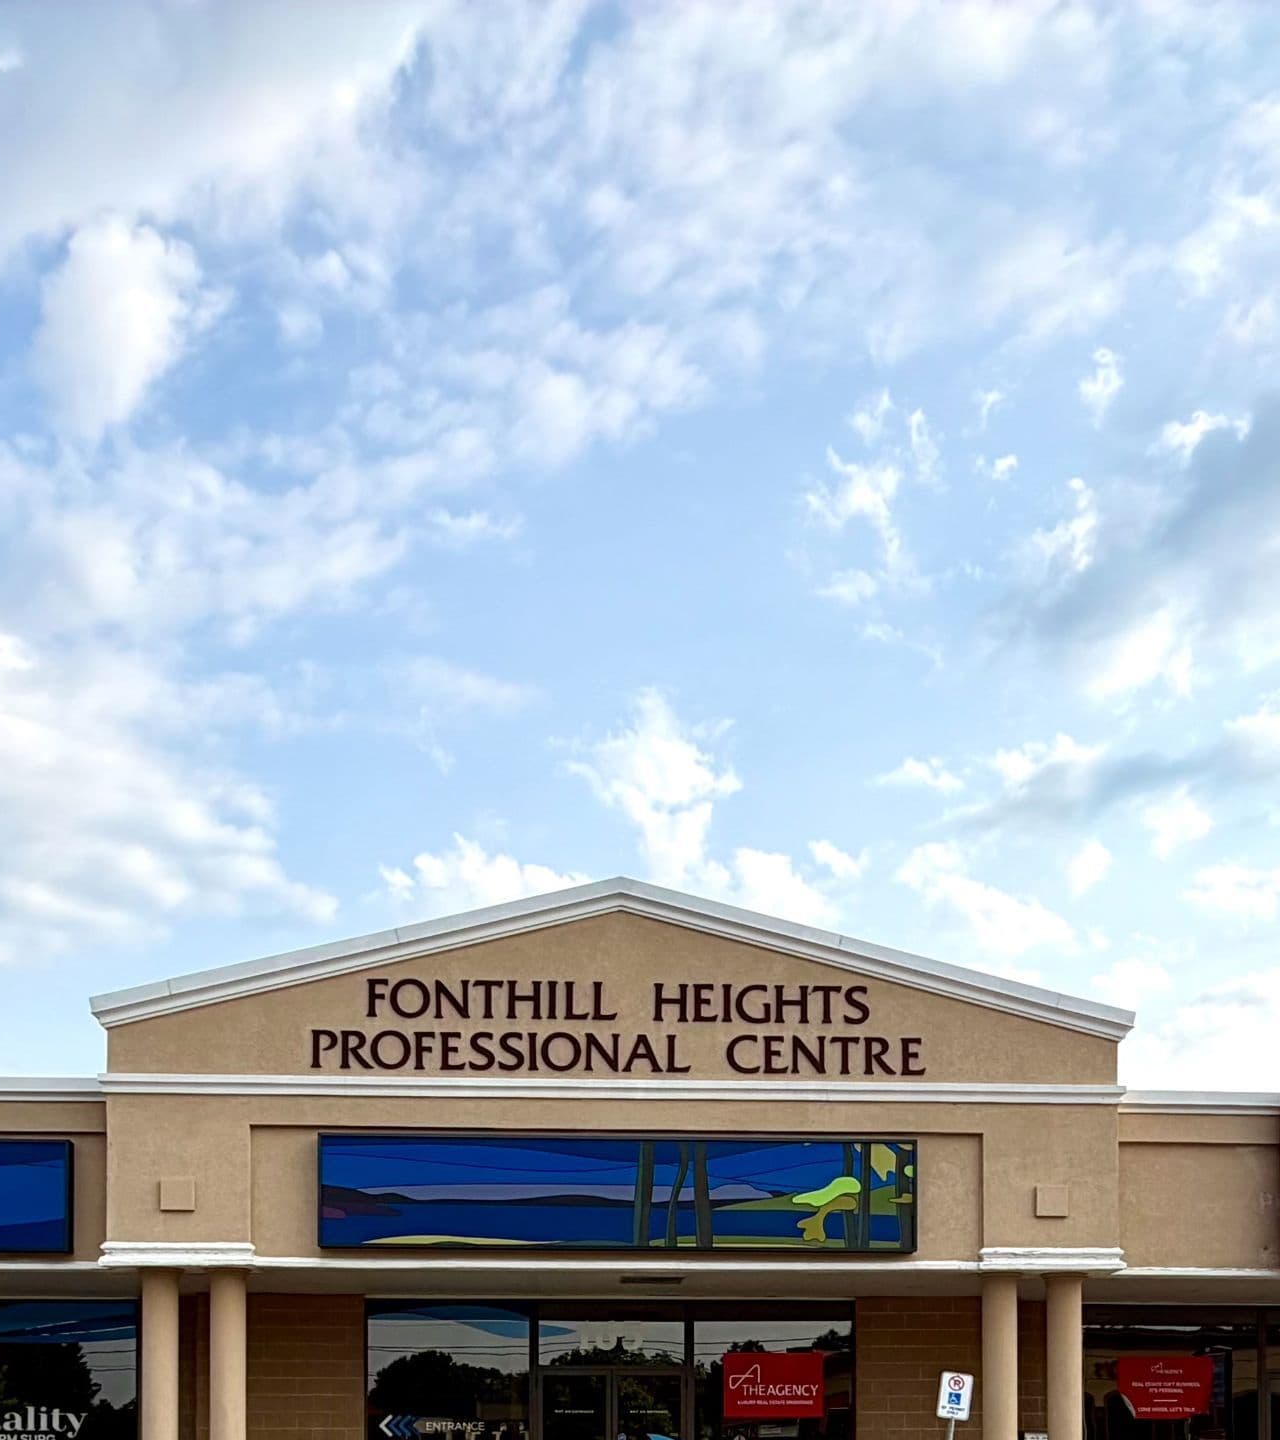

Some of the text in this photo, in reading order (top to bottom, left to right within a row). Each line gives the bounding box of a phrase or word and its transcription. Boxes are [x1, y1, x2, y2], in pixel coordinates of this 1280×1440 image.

[366, 978, 871, 1026] FONTHILL HEIGHTS
[310, 1029, 927, 1077] PROFESSIONAL CENTRE
[425, 1421, 485, 1432] ENTRANCE
